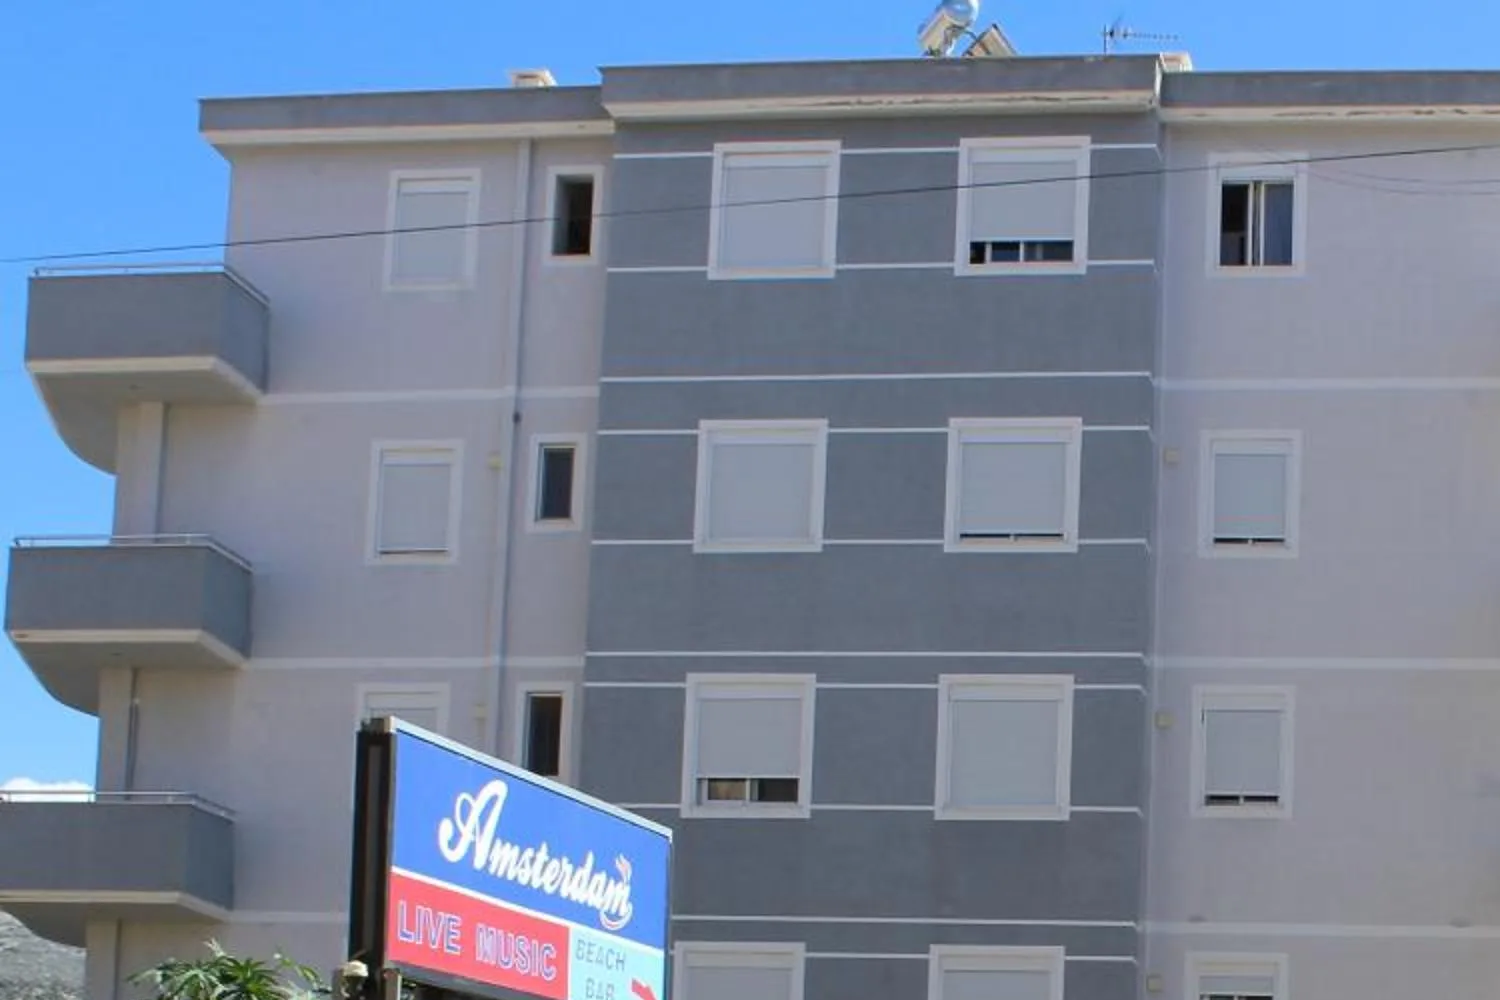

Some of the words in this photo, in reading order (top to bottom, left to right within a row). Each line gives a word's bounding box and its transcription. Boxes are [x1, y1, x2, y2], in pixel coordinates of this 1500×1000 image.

[438, 779, 632, 920] Amsterdam
[397, 900, 462, 956] LIVE
[475, 922, 558, 981] MUSIC
[575, 938, 627, 973] BEACH
